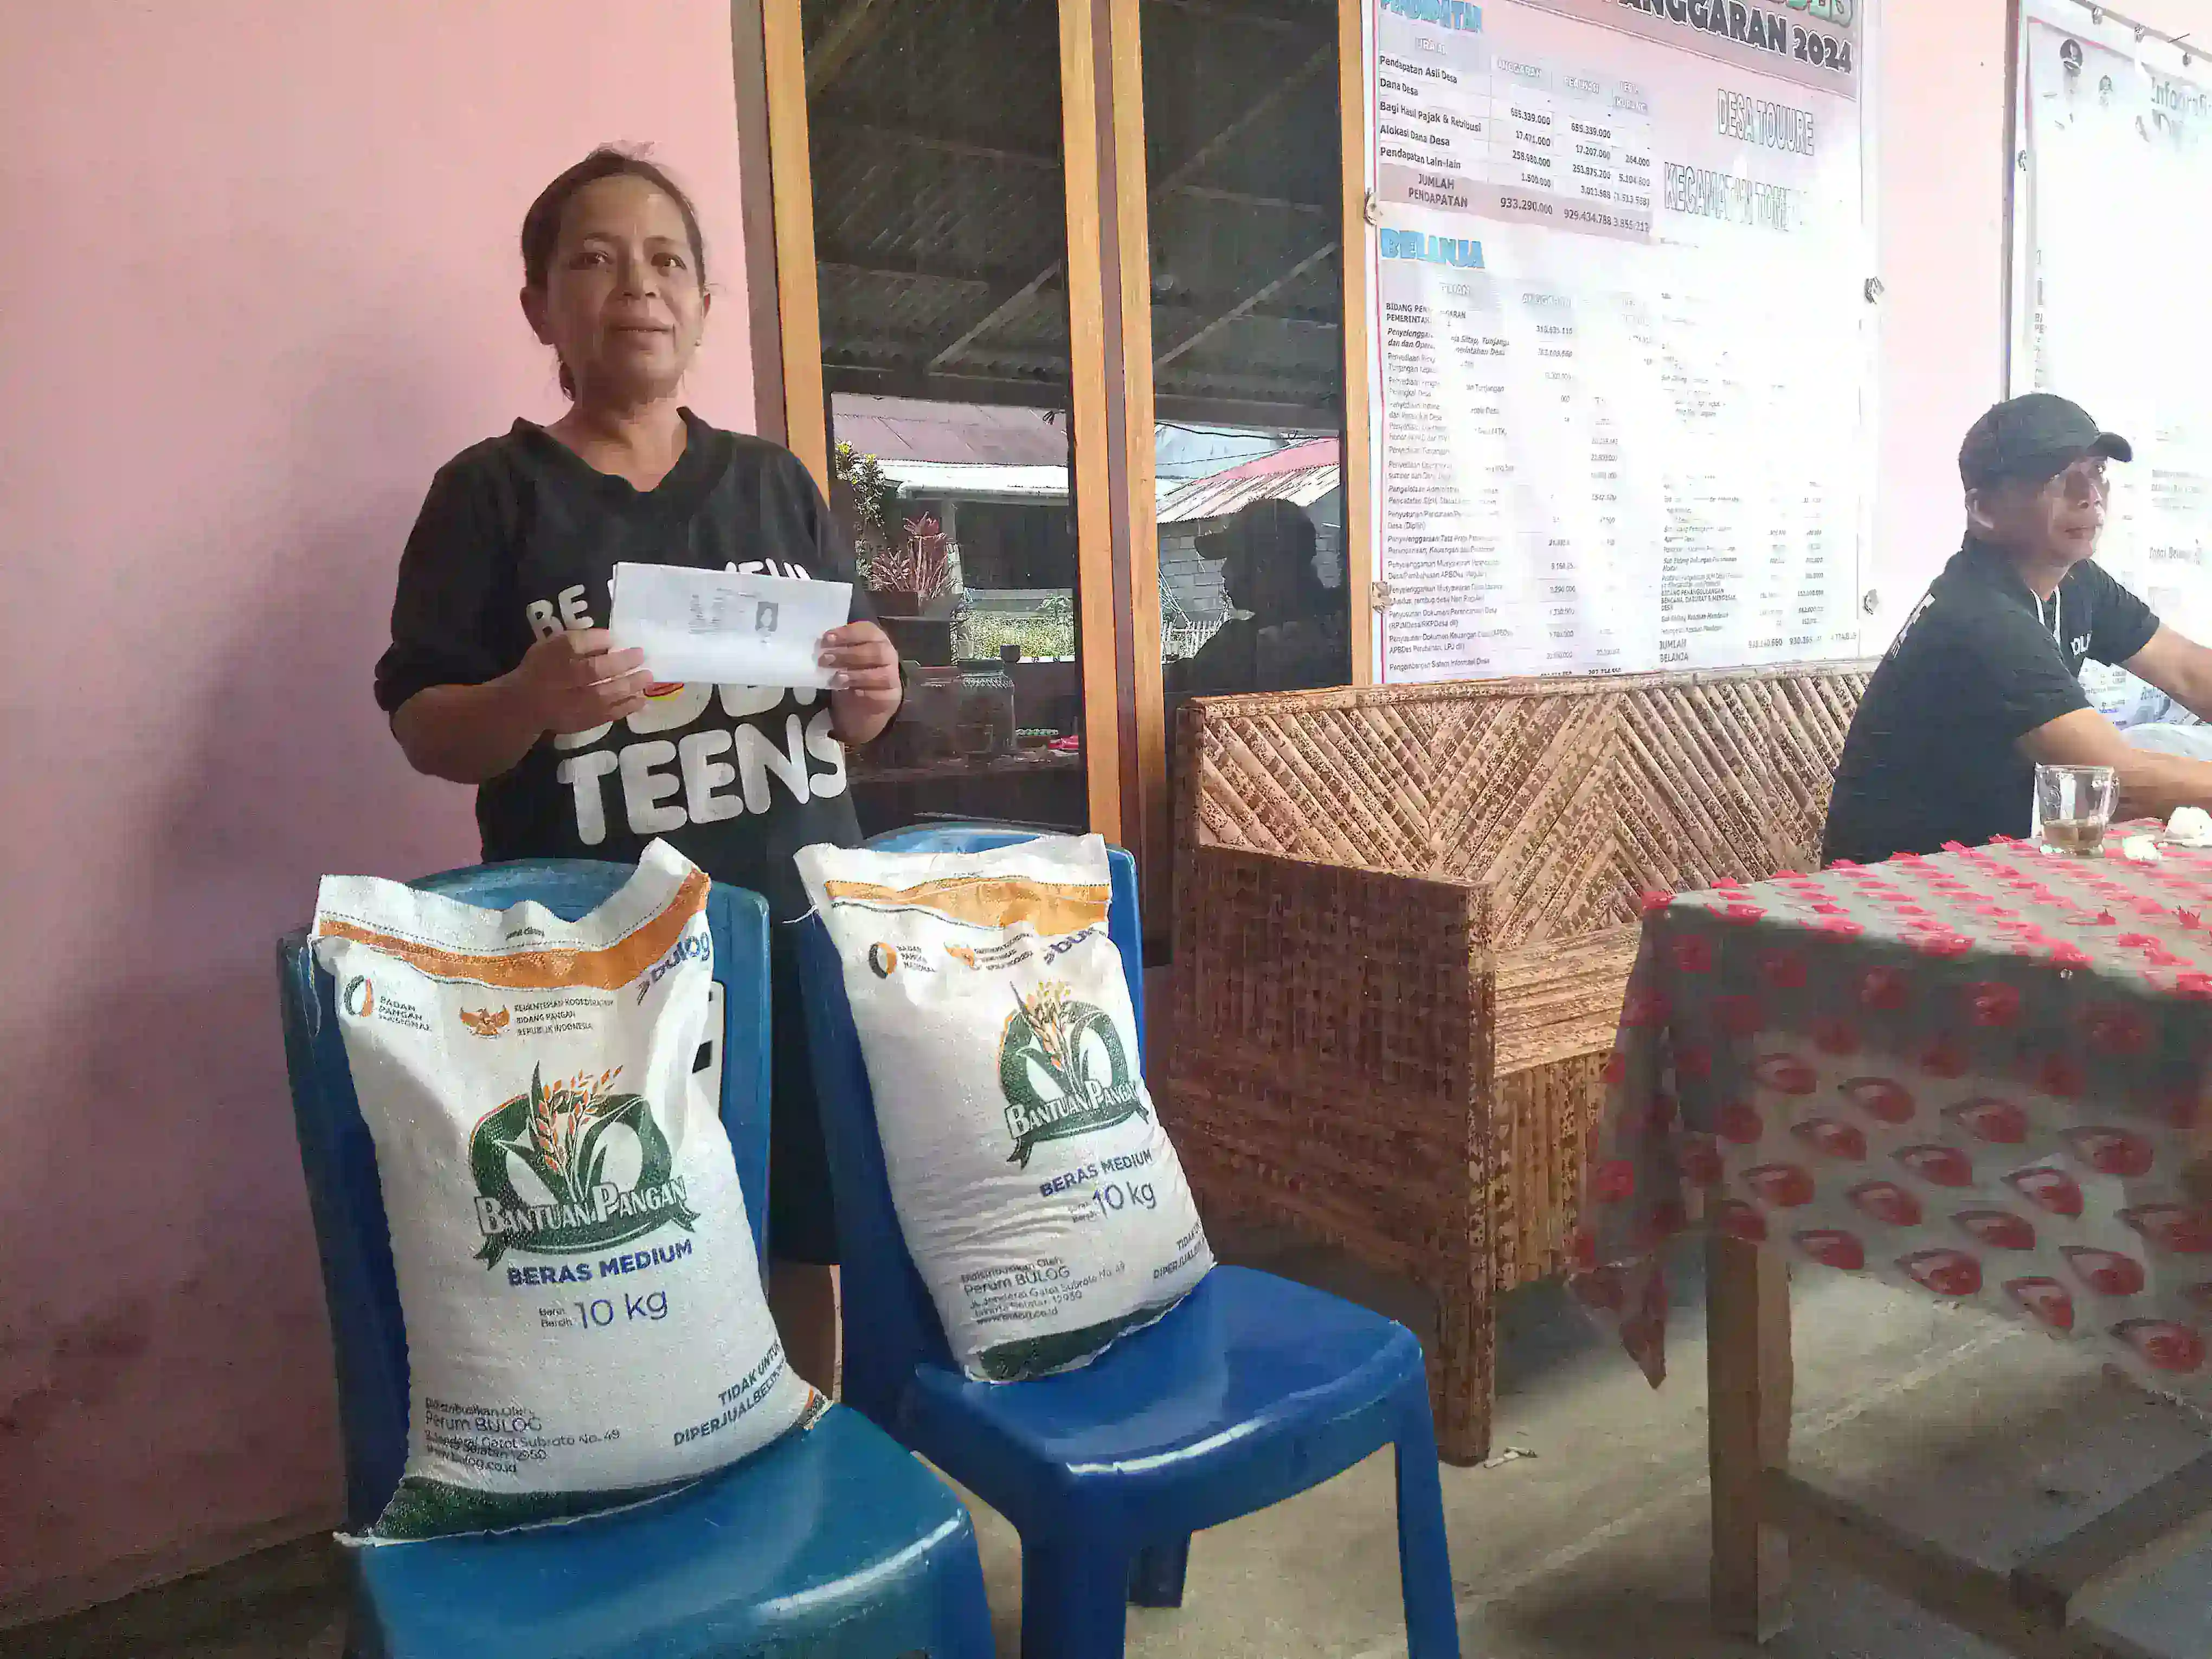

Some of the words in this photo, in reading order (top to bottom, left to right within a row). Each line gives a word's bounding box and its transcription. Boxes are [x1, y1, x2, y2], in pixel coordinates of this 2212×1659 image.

[1791, 25, 1853, 74] 2024
[1380, 55, 1423, 76] Pendapatan
[1425, 66, 1441, 79] Asli
[1442, 70, 1458, 83] Desa
[1380, 78, 1401, 91] Dana
[1402, 83, 1419, 96] Desa
[1380, 101, 1399, 114] Bagi
[1401, 104, 1417, 118] Hasil
[1418, 111, 1441, 124] Pajak
[1718, 88, 1754, 142] DESA
[1380, 125, 1410, 138] Alokasi
[1411, 131, 1427, 143] Dana
[1429, 135, 1450, 146] Desa
[1380, 147, 1425, 164] Pendapatan
[1409, 187, 1468, 208] PENDAPATAN
[1418, 173, 1455, 190] JUMLAH
[1501, 197, 1553, 215] 933.290.000
[526, 583, 594, 645] BE
[557, 708, 847, 845] TEENS
[1004, 1094, 1092, 1139] BANTUAN
[1039, 1163, 1098, 1197] BERAS
[1101, 1148, 1153, 1174] MEDIUM
[474, 1195, 592, 1236] BANTUAN
[592, 1176, 689, 1222] PANGAN
[1092, 1184, 1125, 1219] 10
[1126, 1180, 1157, 1210] kg
[507, 1262, 593, 1287] BERAS
[599, 1238, 693, 1278] MEDIUM
[963, 1278, 1012, 1297] Perum
[1014, 1265, 1070, 1286] BULOG
[574, 1300, 614, 1329] 10
[625, 1290, 668, 1320] kg
[718, 1368, 757, 1406] TIDAK
[474, 1416, 542, 1433] BULOG
